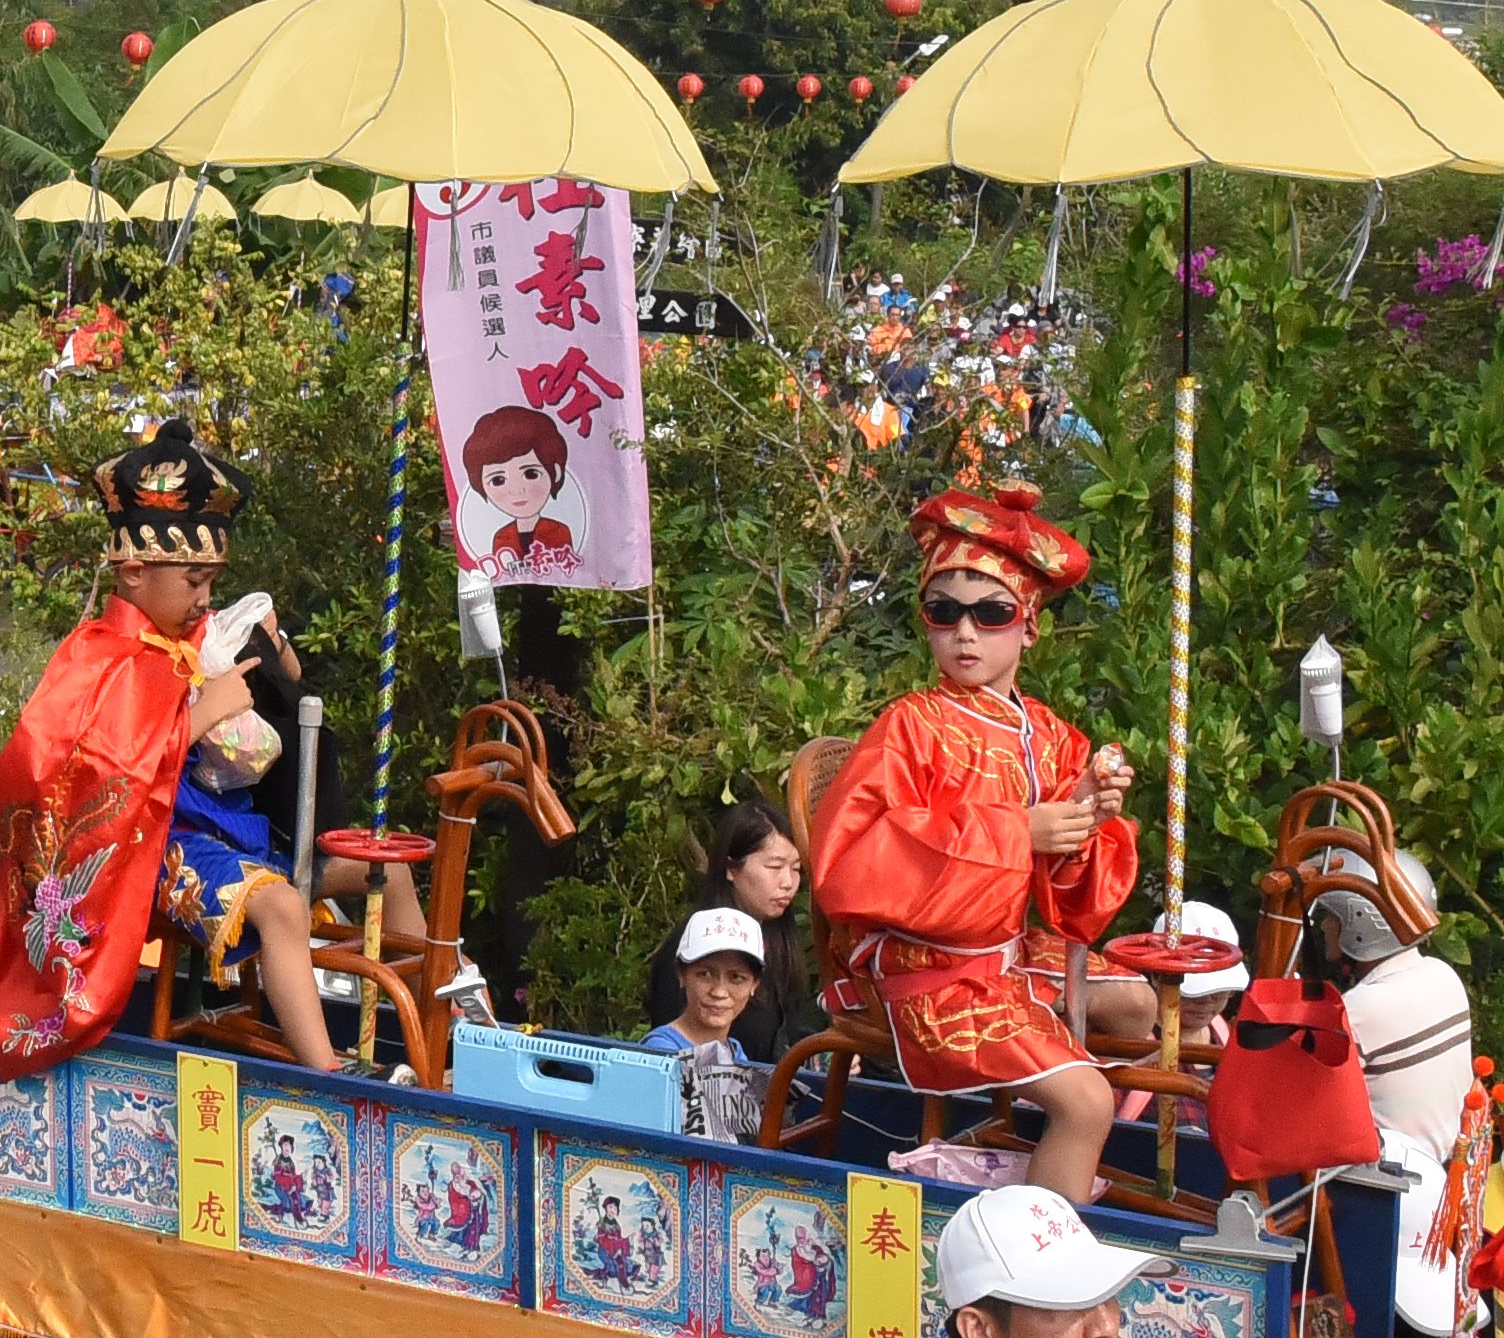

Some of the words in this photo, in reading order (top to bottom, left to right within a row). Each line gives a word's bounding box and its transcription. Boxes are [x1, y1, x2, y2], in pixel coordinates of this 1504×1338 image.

[470, 221, 510, 362] 市議員候選人
